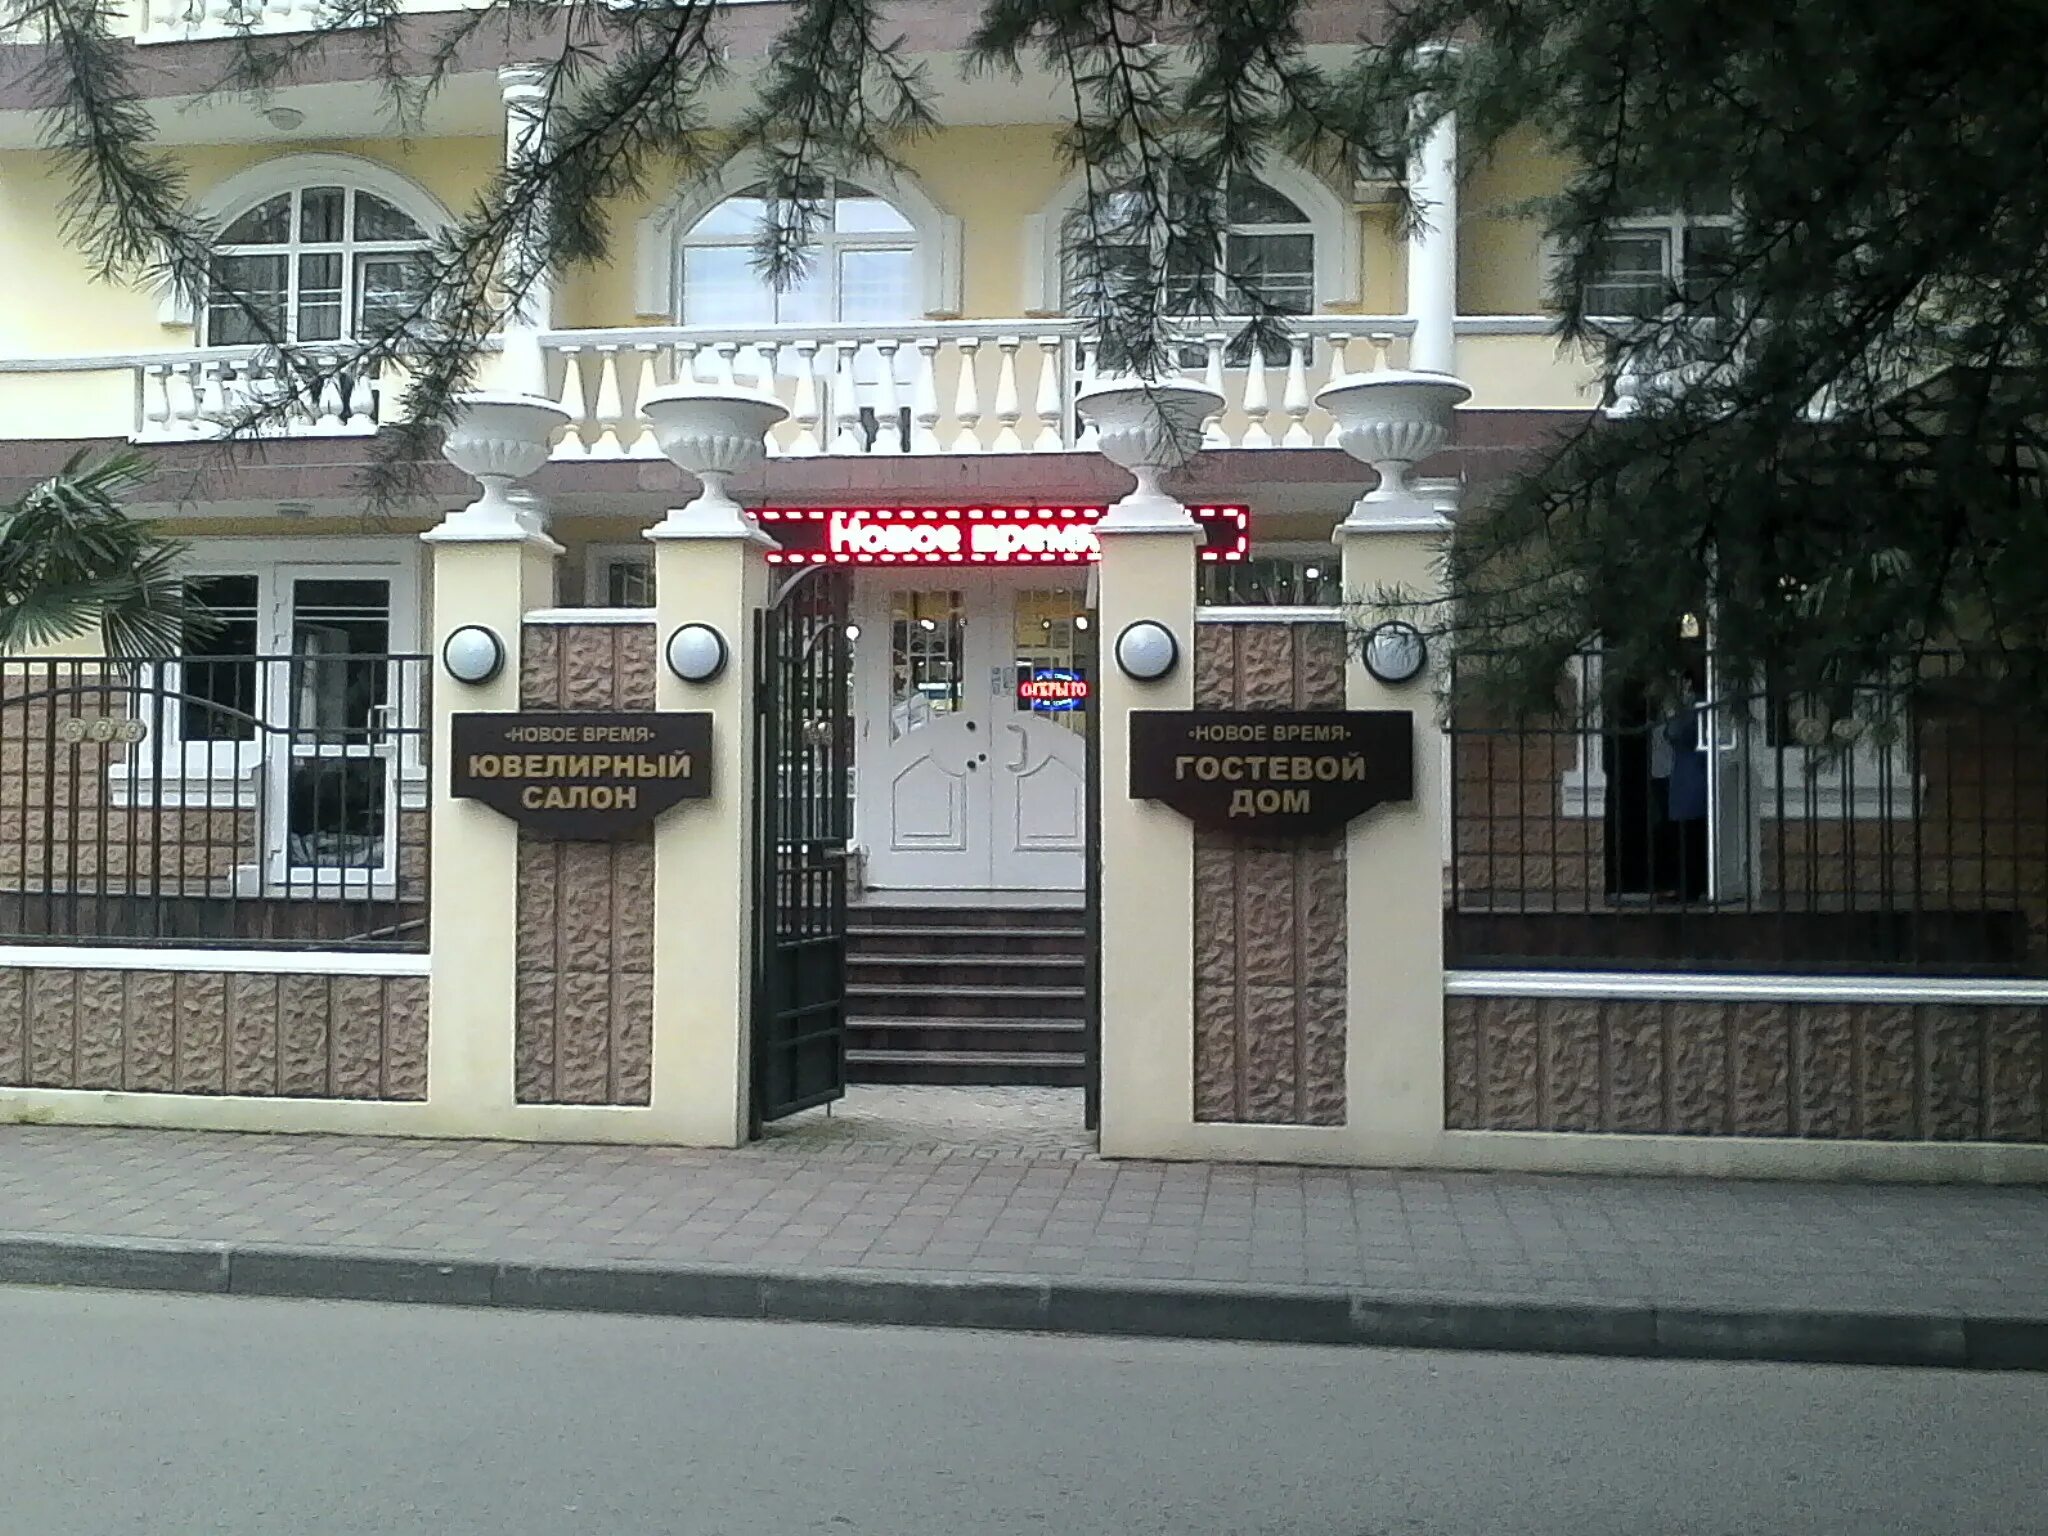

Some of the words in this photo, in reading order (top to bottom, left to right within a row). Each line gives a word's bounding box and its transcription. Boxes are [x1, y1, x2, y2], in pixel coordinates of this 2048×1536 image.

[828, 514, 962, 552] Новое
[469, 749, 691, 778] ЮВЕЛИРНЫЙ
[1174, 751, 1366, 780] ГОСТЕВОЙ
[521, 785, 637, 809] САЛОН
[1229, 789, 1311, 818] ДОМ
